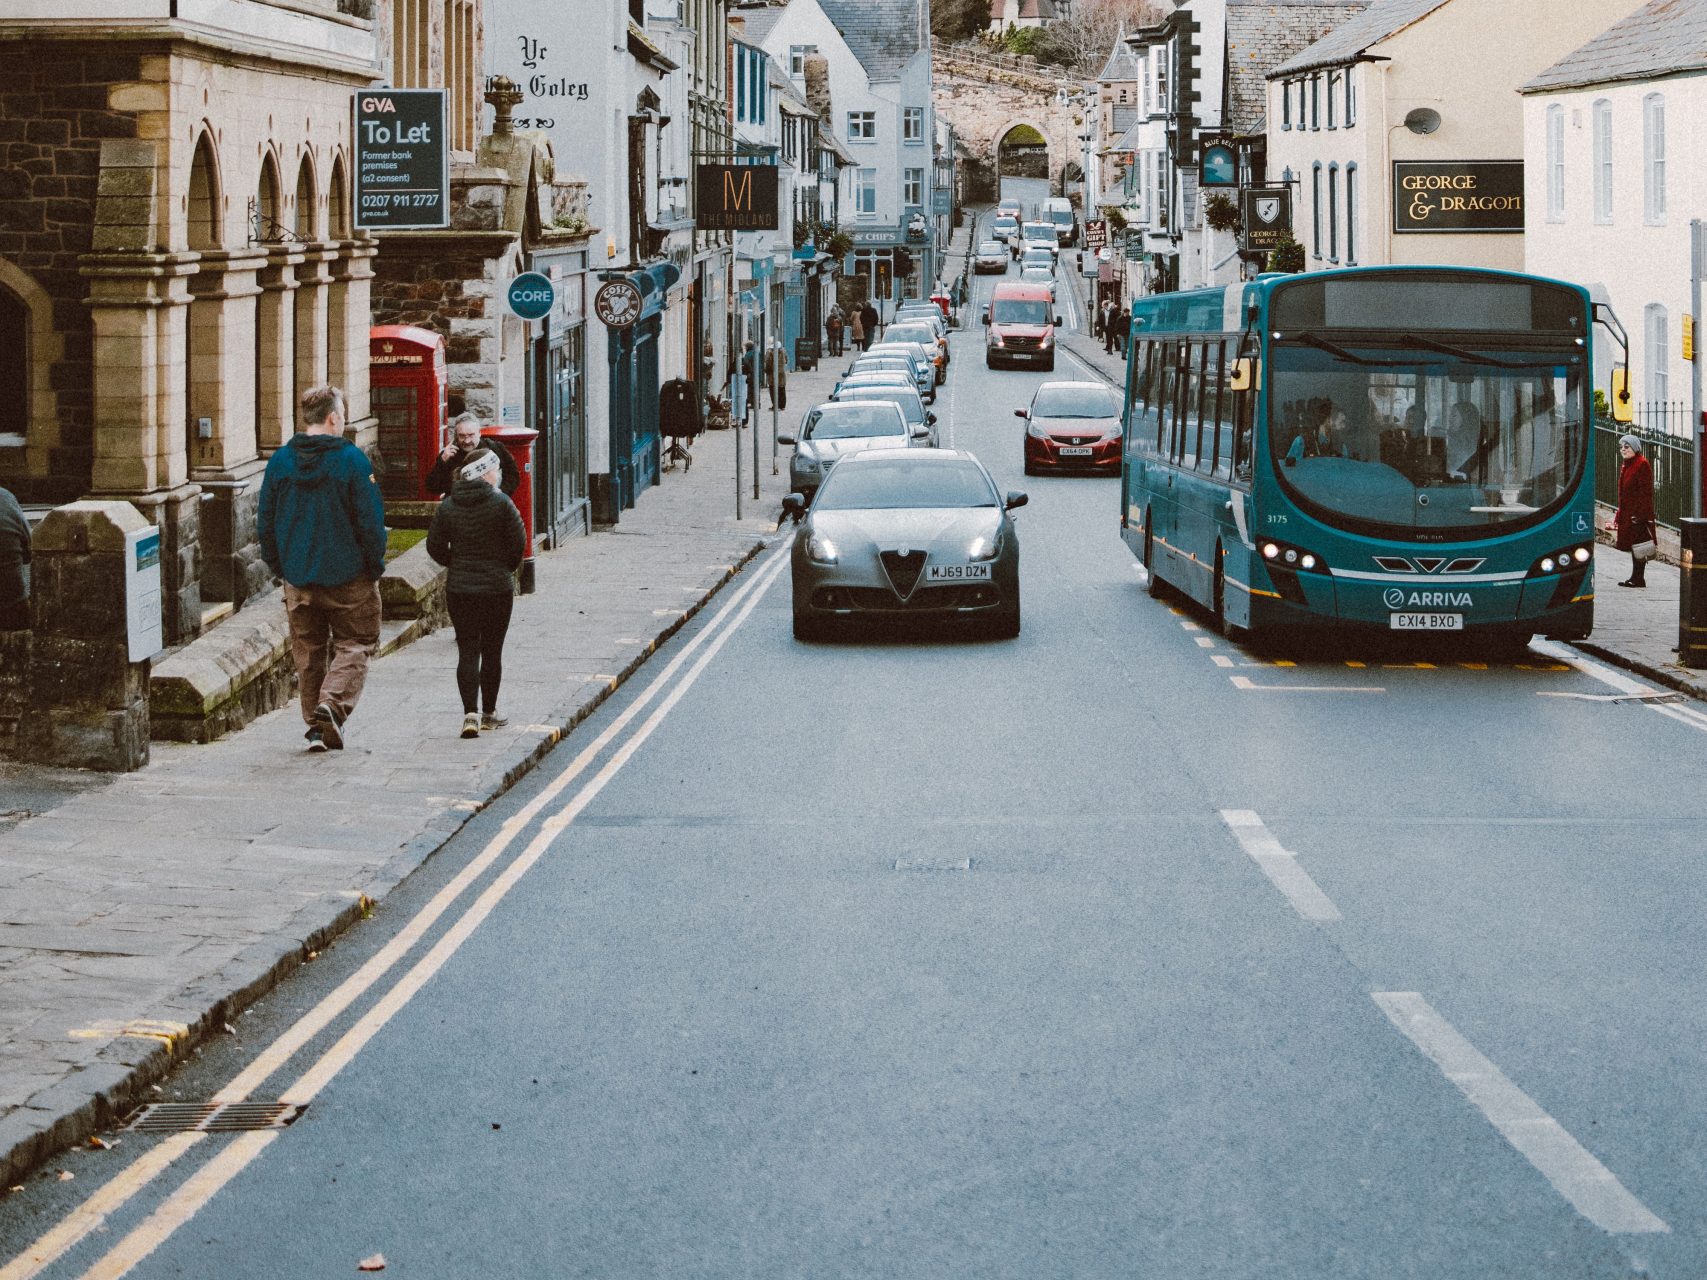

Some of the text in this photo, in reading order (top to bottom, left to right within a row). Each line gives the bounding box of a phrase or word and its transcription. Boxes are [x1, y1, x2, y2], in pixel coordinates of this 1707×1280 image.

[529, 74, 589, 101] Goleg
[362, 97, 396, 113] GVA
[362, 120, 431, 144] To Let
[1203, 138, 1220, 148] BLUE
[362, 150, 412, 160] Former bank
[362, 161, 398, 172] premises
[362, 173, 410, 184] (a2 consent)
[1402, 175, 1477, 190] GEORGE
[724, 170, 751, 211] M
[362, 194, 439, 207] 0207 911 2727
[1409, 191, 1436, 220] &
[703, 213, 773, 226] THE MIDLAND
[865, 232, 896, 240] CHIPS
[1249, 230, 1278, 238] GEORGE
[511, 290, 551, 302] CORE
[603, 285, 632, 299] COSTA
[602, 308, 637, 324] COFFEE
[1267, 514, 1288, 524] 3175
[931, 565, 987, 577] MJ69 DZM
[1407, 591, 1473, 606] ARRIVA
[1398, 615, 1426, 627] CX14
